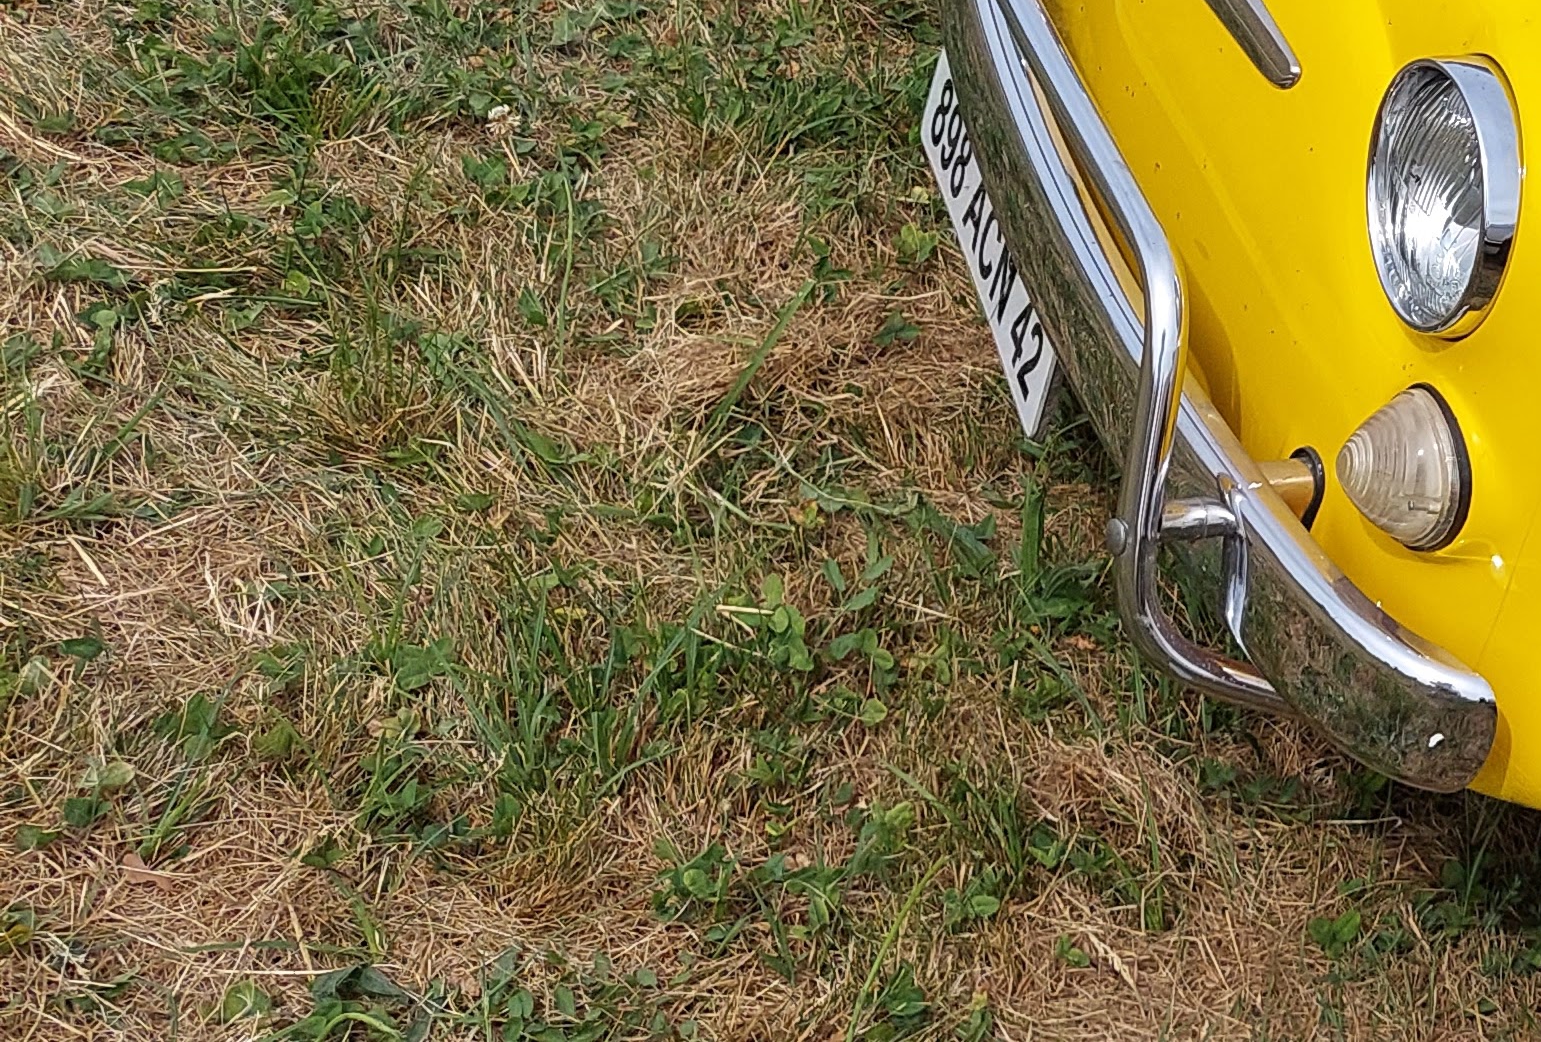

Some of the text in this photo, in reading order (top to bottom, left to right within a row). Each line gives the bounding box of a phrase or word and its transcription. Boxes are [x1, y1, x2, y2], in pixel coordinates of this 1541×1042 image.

[931, 78, 1044, 402] 898 ACN 42
